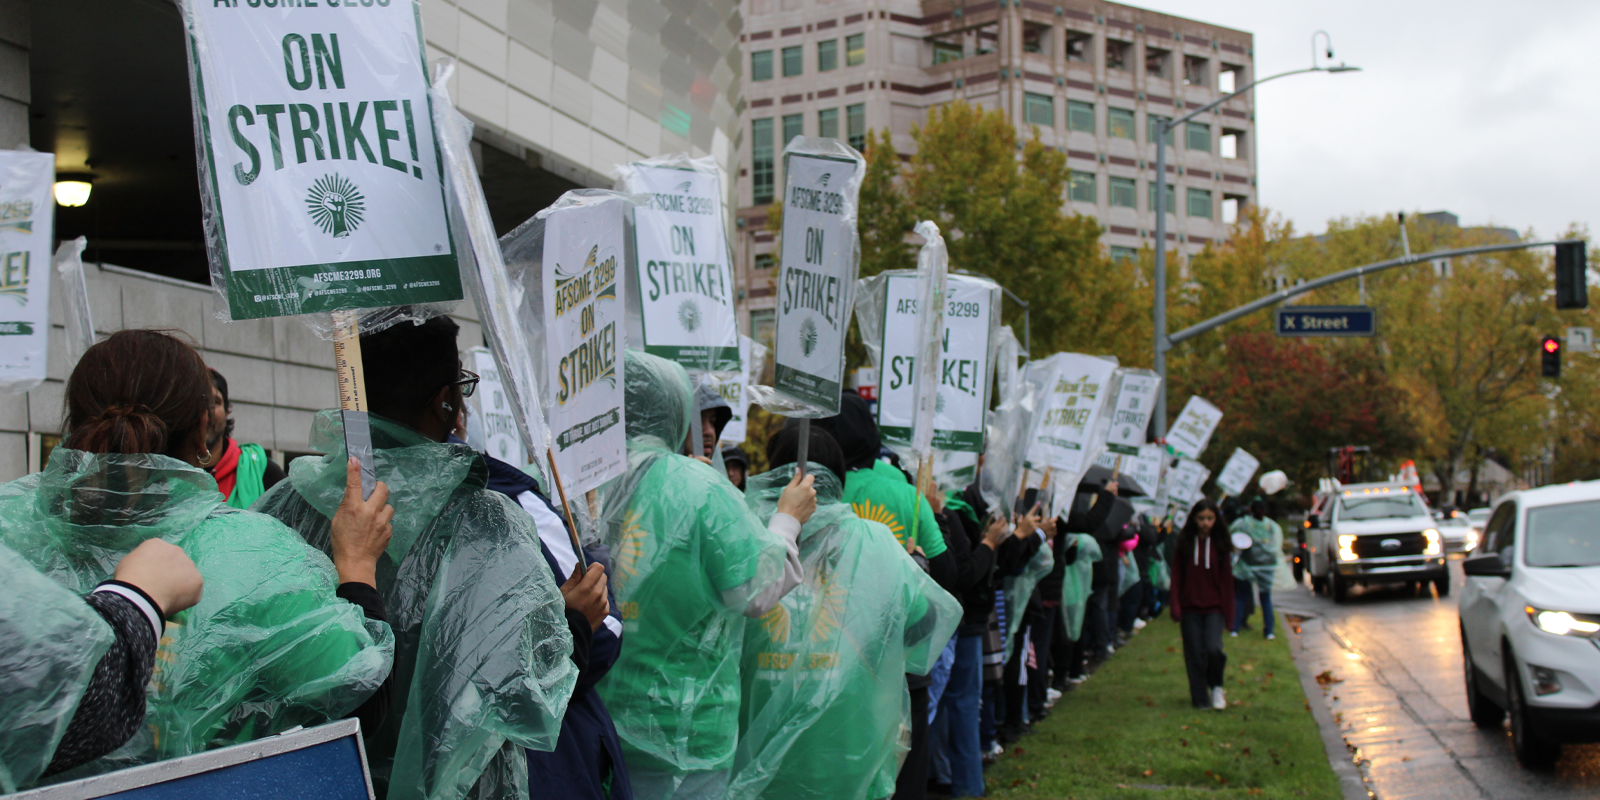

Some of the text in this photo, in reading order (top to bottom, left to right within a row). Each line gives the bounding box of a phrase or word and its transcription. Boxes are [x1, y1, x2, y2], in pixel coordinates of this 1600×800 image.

[281, 33, 346, 91] ON
[227, 99, 423, 186] STRIKE!
[687, 196, 714, 215] 3299
[670, 225, 696, 256] ON
[805, 226, 825, 266] ON
[313, 268, 382, 283] AFSCME3299.ORG
[555, 255, 616, 319] AFSCME 3299
[646, 260, 726, 306] STRIKE!
[783, 266, 841, 332] STRIKE!
[896, 299, 980, 318] AFS 3299
[580, 302, 595, 338] ON
[1284, 315, 1349, 329] X Street
[558, 320, 616, 406] STRIKE!
[890, 355, 979, 397] STKE!
[493, 390, 505, 410] ON
[718, 382, 741, 400] IKE!
[1129, 397, 1141, 410] ON
[485, 412, 518, 442] STRIKE!
[1043, 408, 1092, 427] STRIKE!
[1113, 409, 1147, 431] STRIKE!
